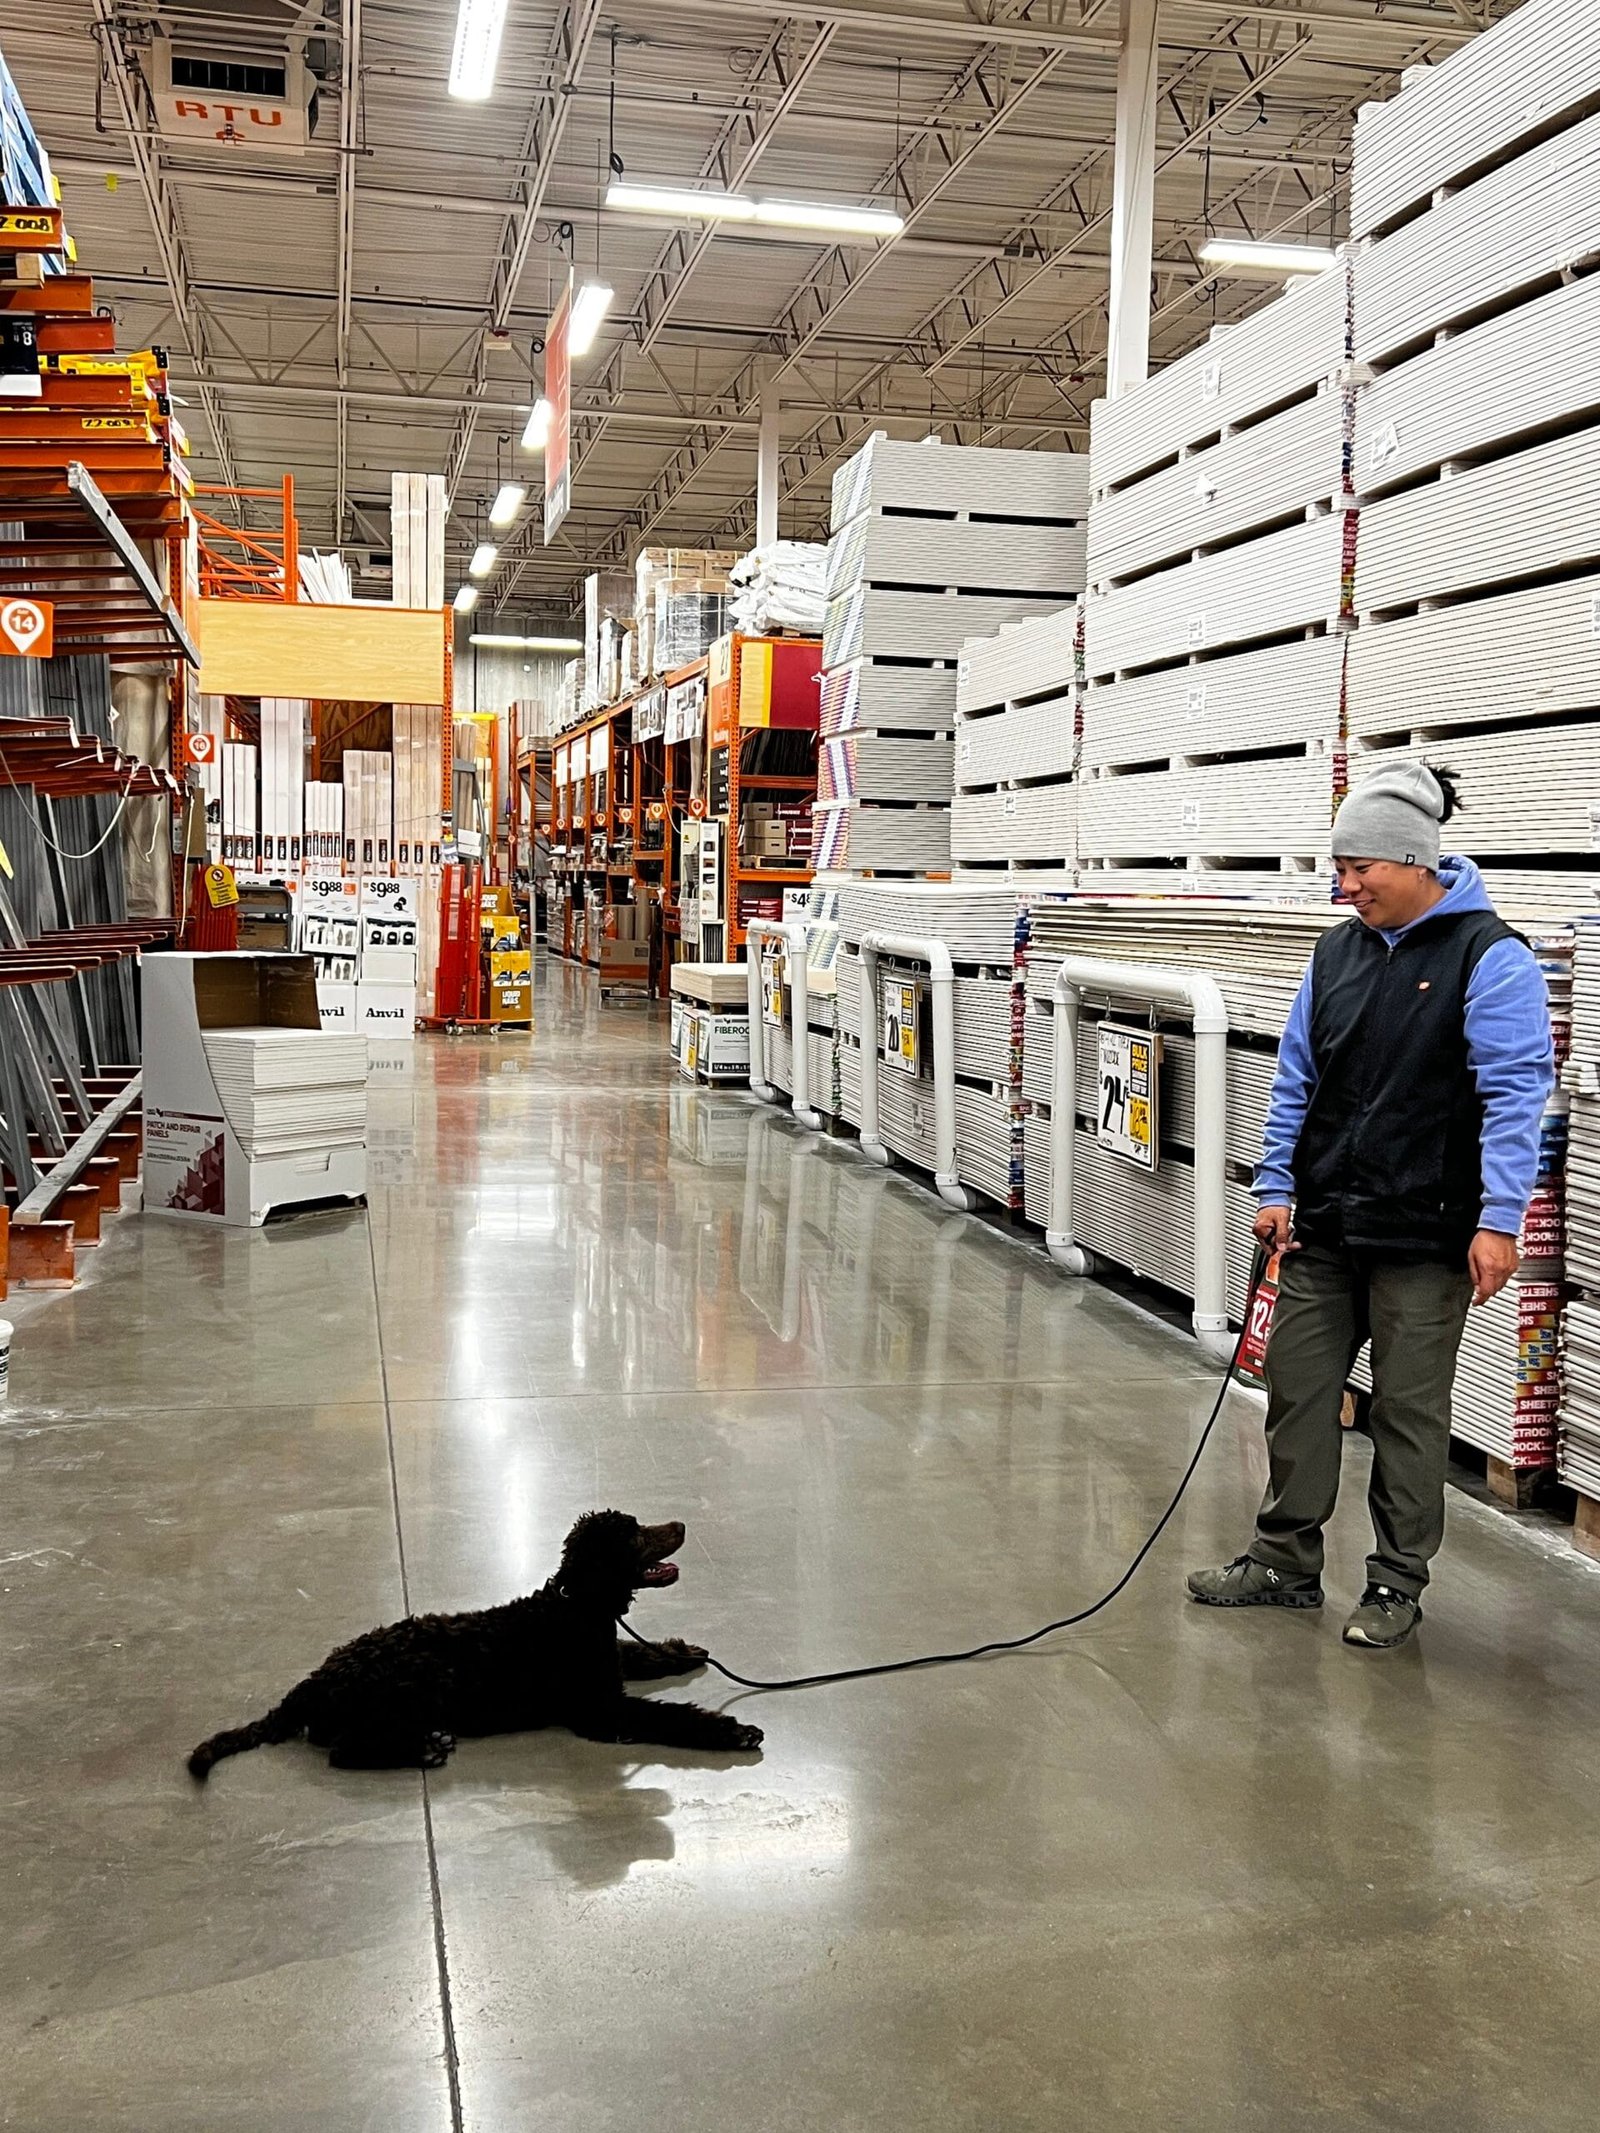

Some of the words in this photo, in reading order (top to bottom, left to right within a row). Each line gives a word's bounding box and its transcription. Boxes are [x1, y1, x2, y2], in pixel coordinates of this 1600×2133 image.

[175, 100, 282, 127] RTU
[12, 615, 34, 631] 14
[319, 1006, 345, 1017] nvil
[366, 1008, 405, 1018] Anvil
[1132, 1044, 1148, 1059] BULK
[1132, 1056, 1148, 1073] PRICE
[147, 1120, 165, 1130] PATCH
[166, 1122, 179, 1131] AND
[180, 1124, 201, 1134] REPAIR
[147, 1129, 169, 1139] PANELS
